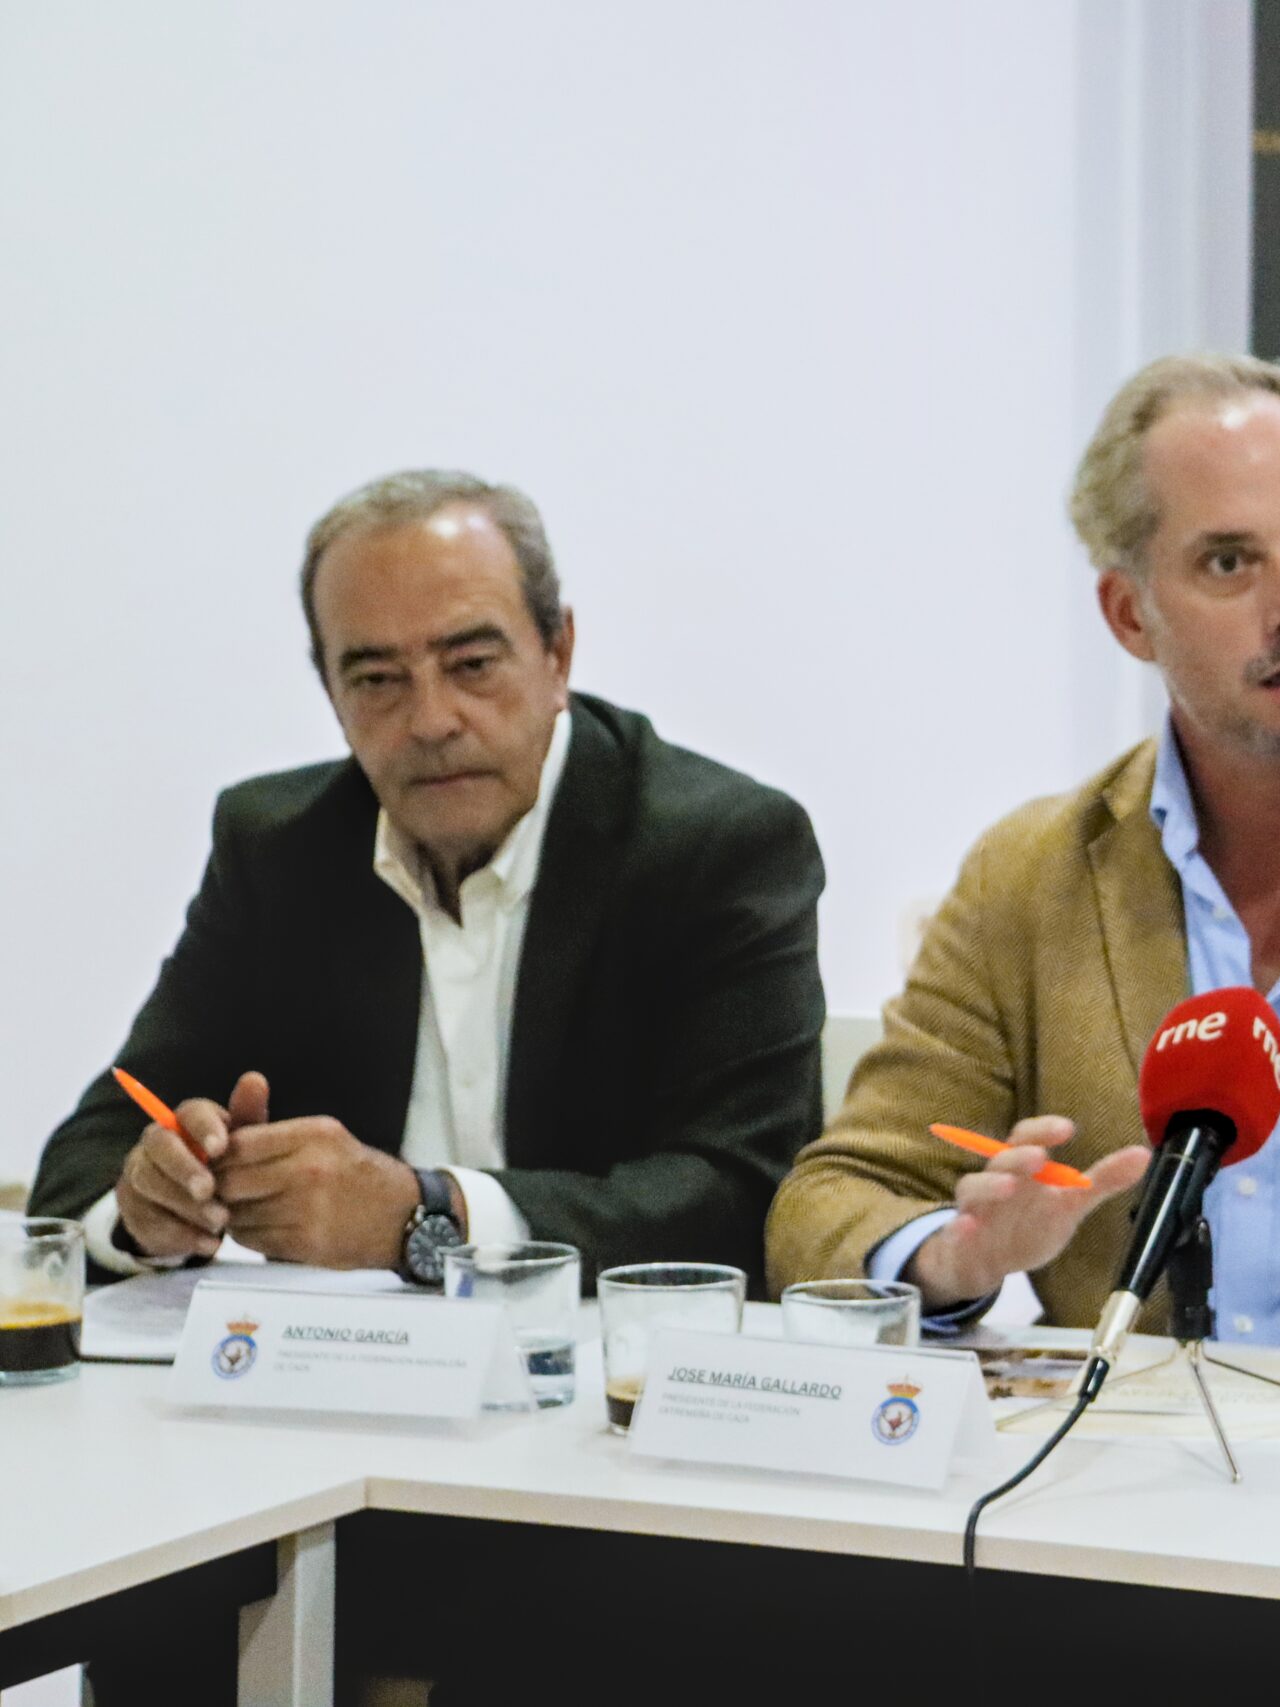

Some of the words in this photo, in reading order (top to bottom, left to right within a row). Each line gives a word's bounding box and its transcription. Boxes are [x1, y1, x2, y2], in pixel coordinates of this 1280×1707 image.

[1156, 1011, 1227, 1052] rne
[283, 1325, 351, 1341] ANTONIO
[355, 1328, 409, 1344] GARCÍA
[709, 1370, 757, 1388] MARÍA
[761, 1376, 842, 1400] GALLARDO
